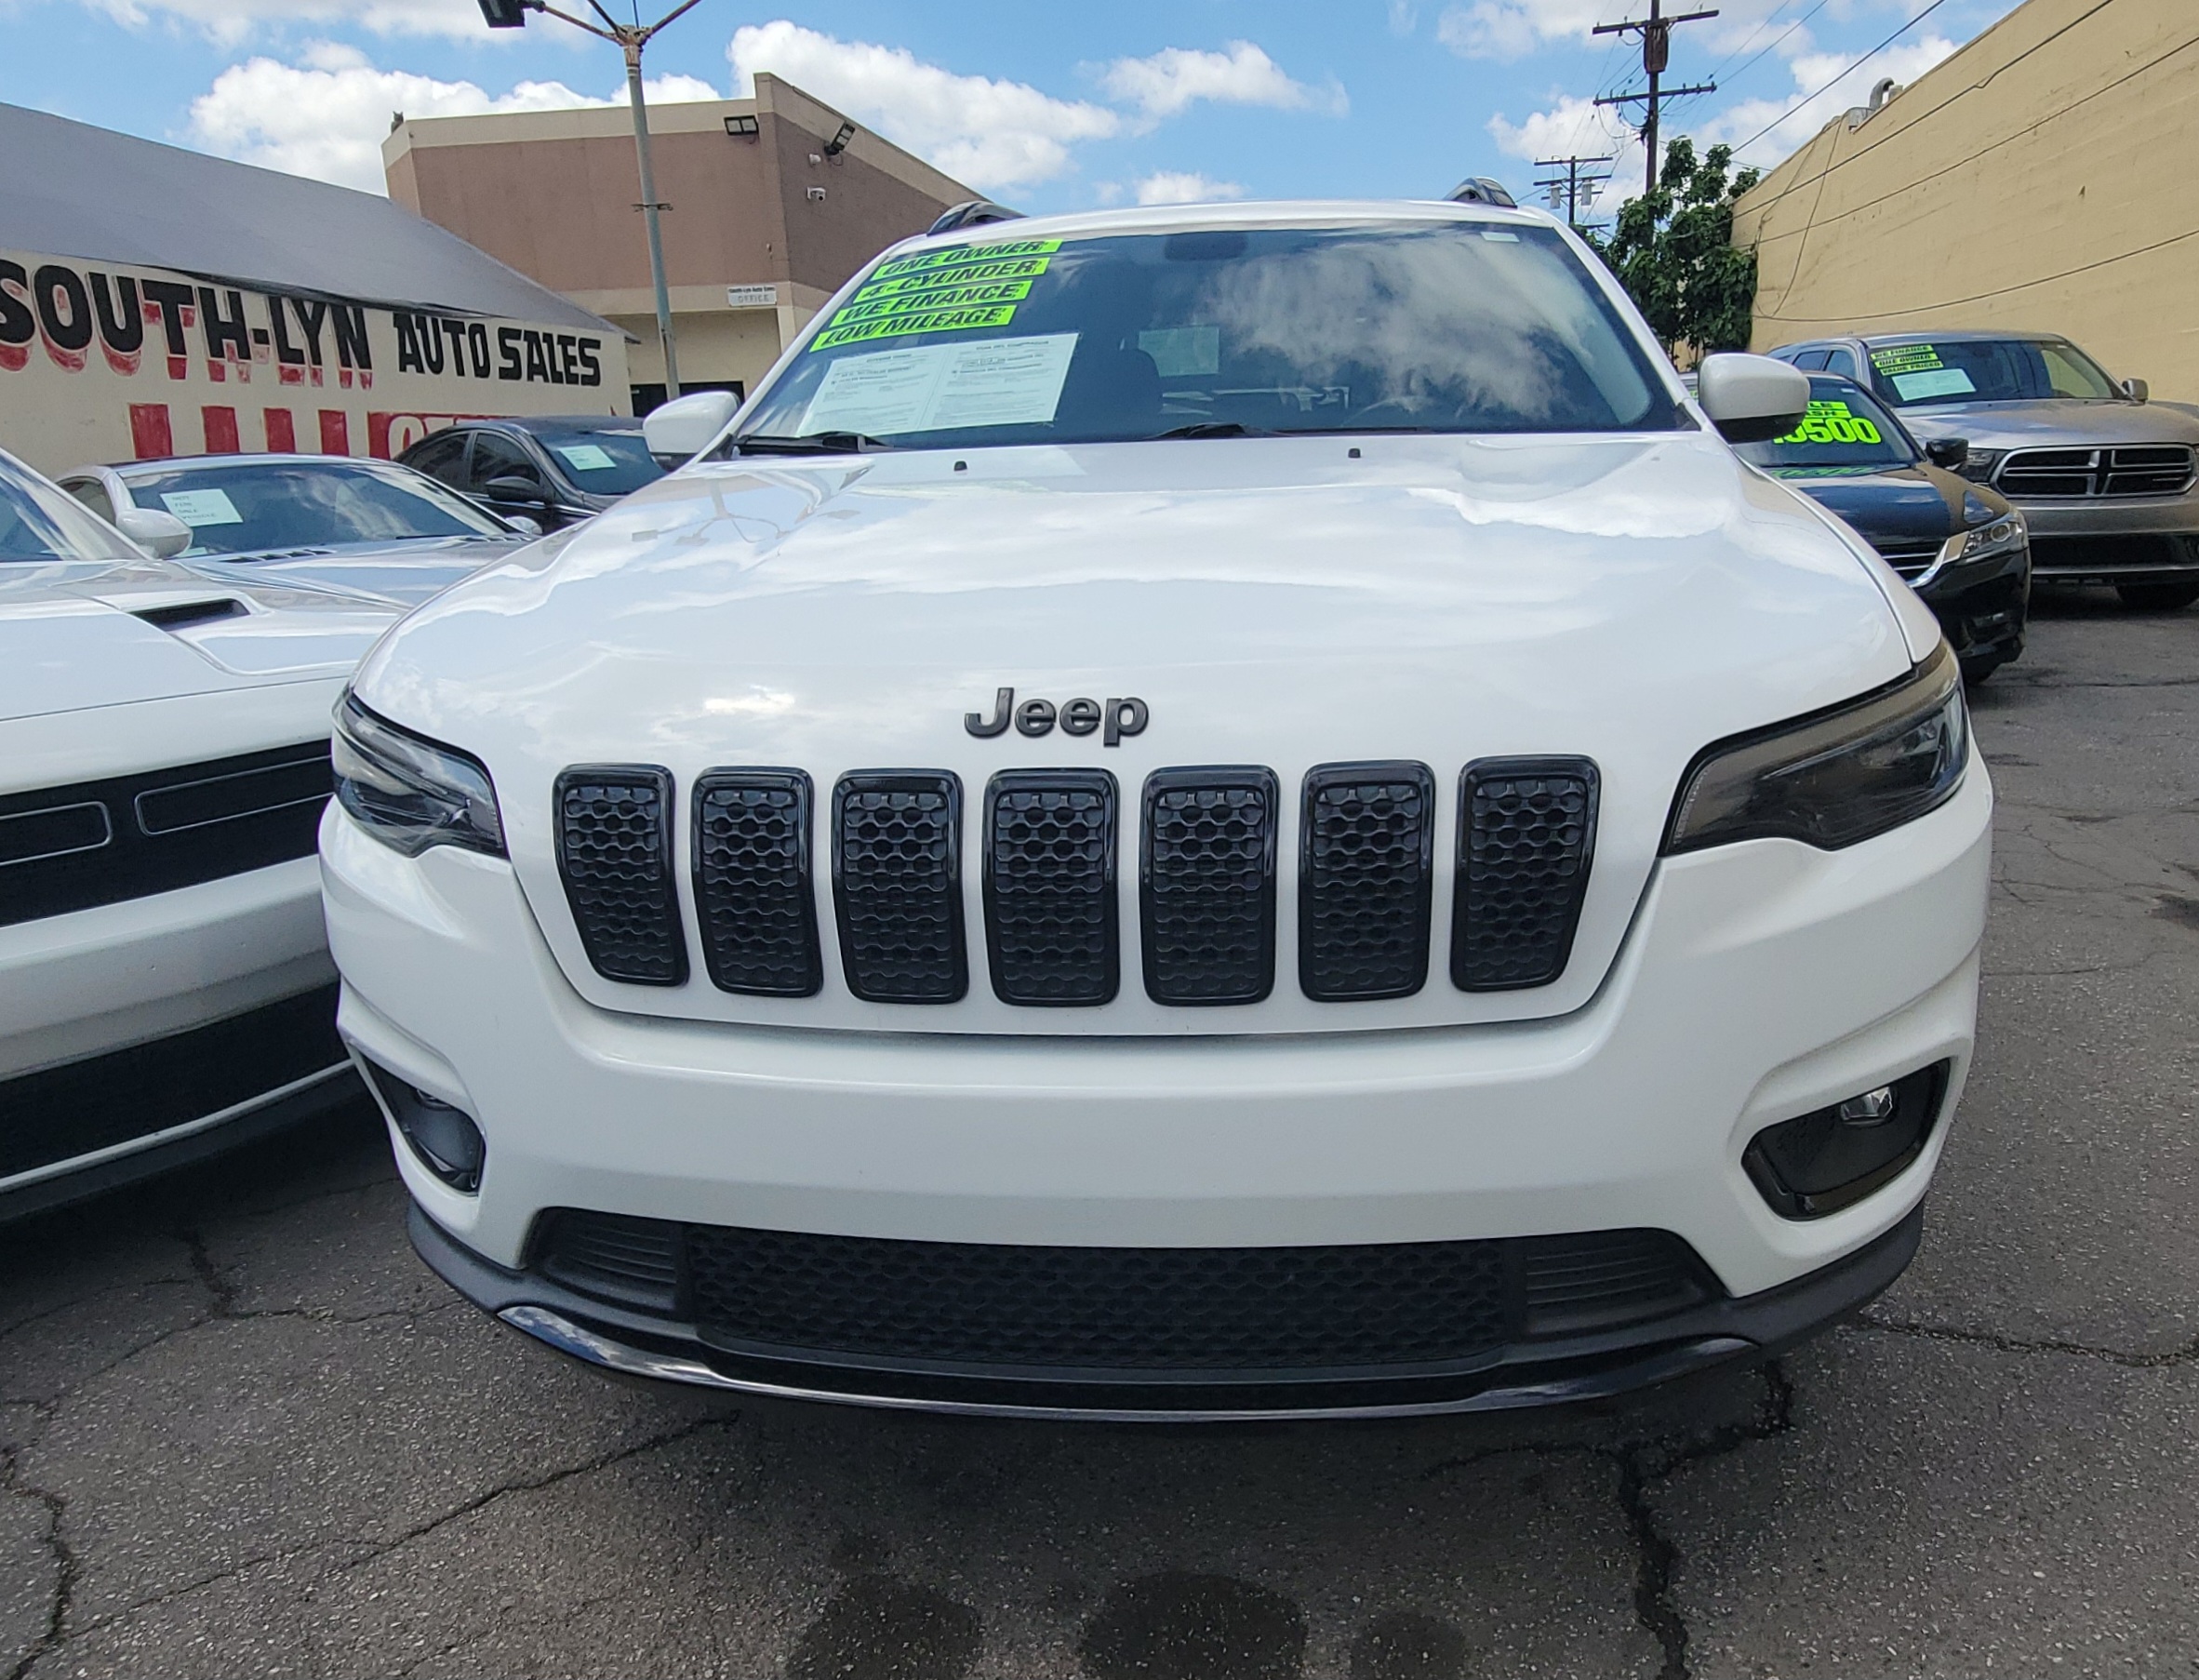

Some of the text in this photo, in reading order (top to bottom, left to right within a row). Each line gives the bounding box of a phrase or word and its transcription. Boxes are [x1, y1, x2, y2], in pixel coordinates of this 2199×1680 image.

[885, 241, 1046, 274] ONE OWNER
[862, 260, 1042, 299] 4-CYLINDER
[0, 259, 602, 386] SOUTH-LYN AUTO SALES
[840, 283, 1021, 323] WE FINANCE
[820, 306, 1006, 347] LOW MILEAGE
[965, 687, 1150, 748] Jeep
